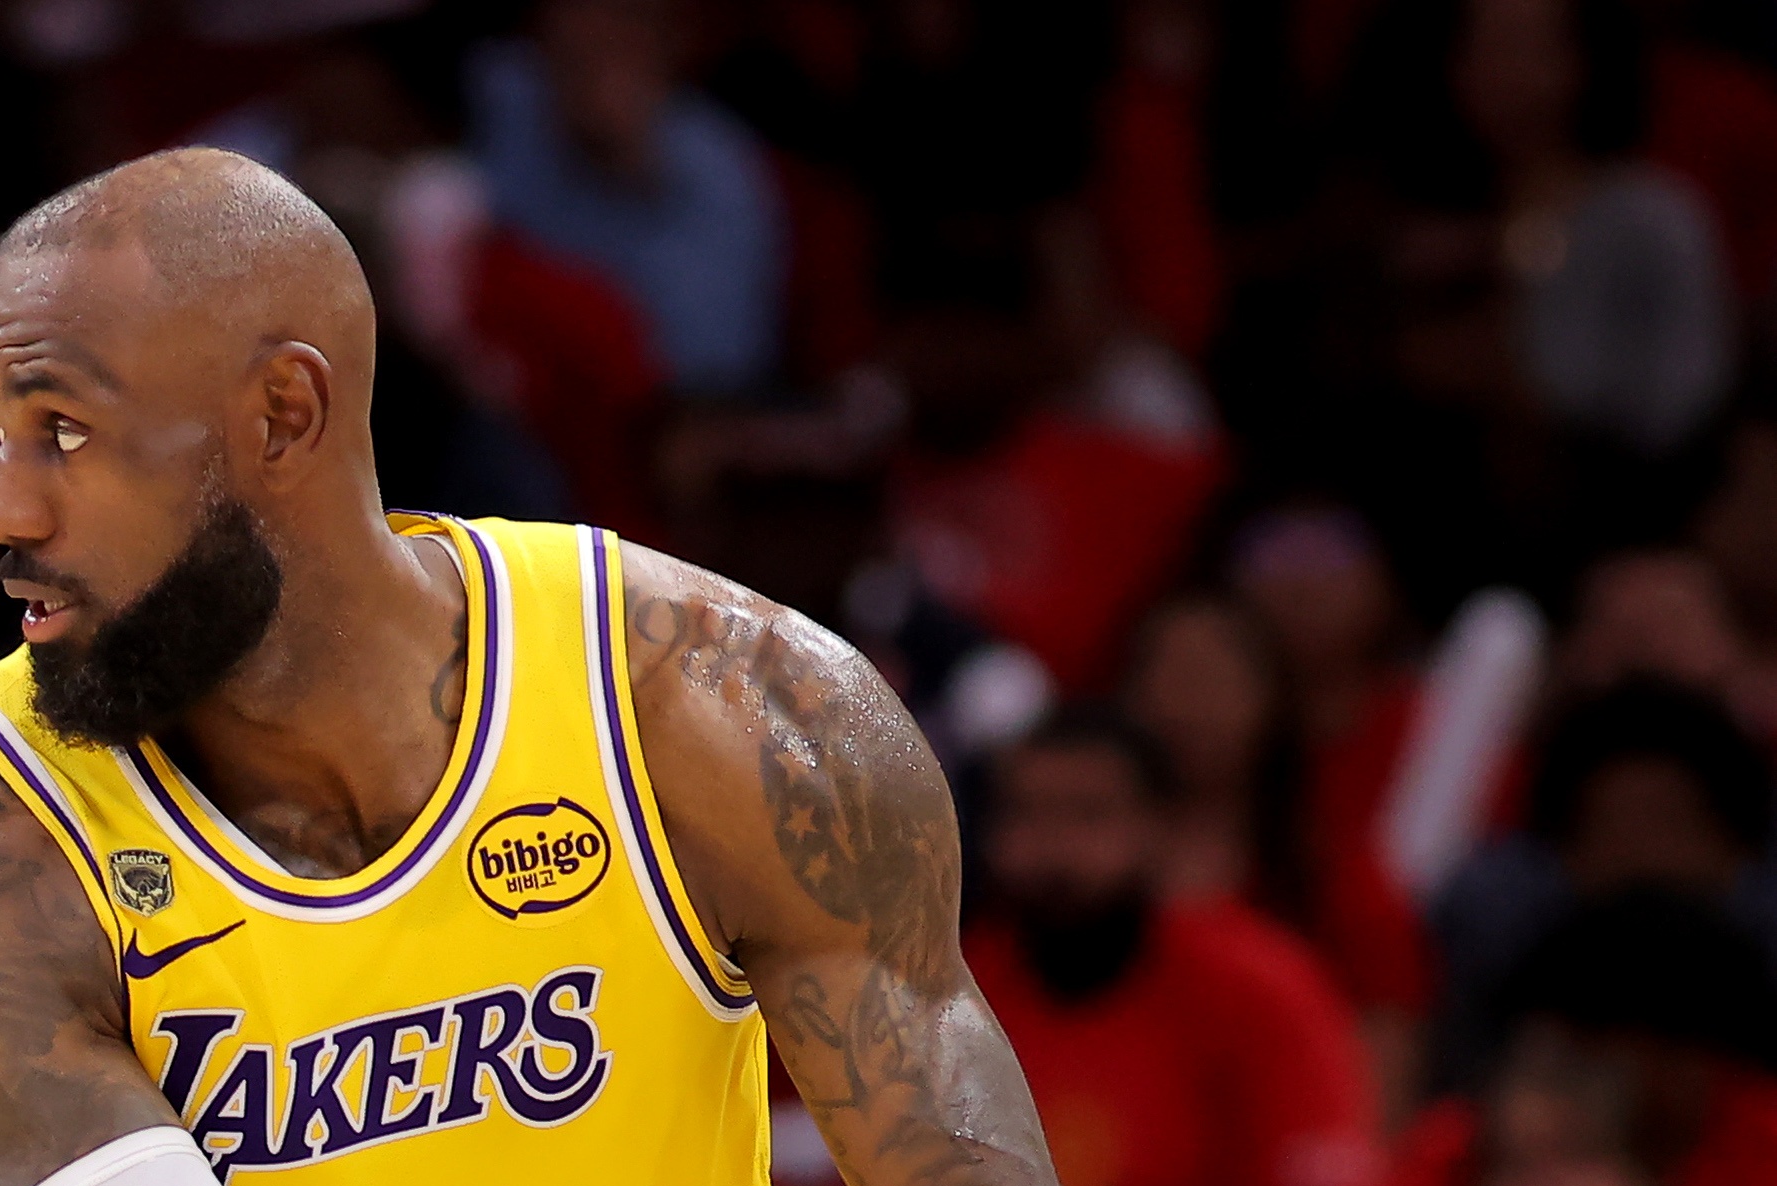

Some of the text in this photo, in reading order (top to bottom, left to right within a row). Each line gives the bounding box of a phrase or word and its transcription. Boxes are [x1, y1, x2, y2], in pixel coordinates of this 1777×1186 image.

[113, 854, 164, 865] LEGACY
[478, 830, 601, 880] bibigo
[505, 869, 558, 894] 비비고
